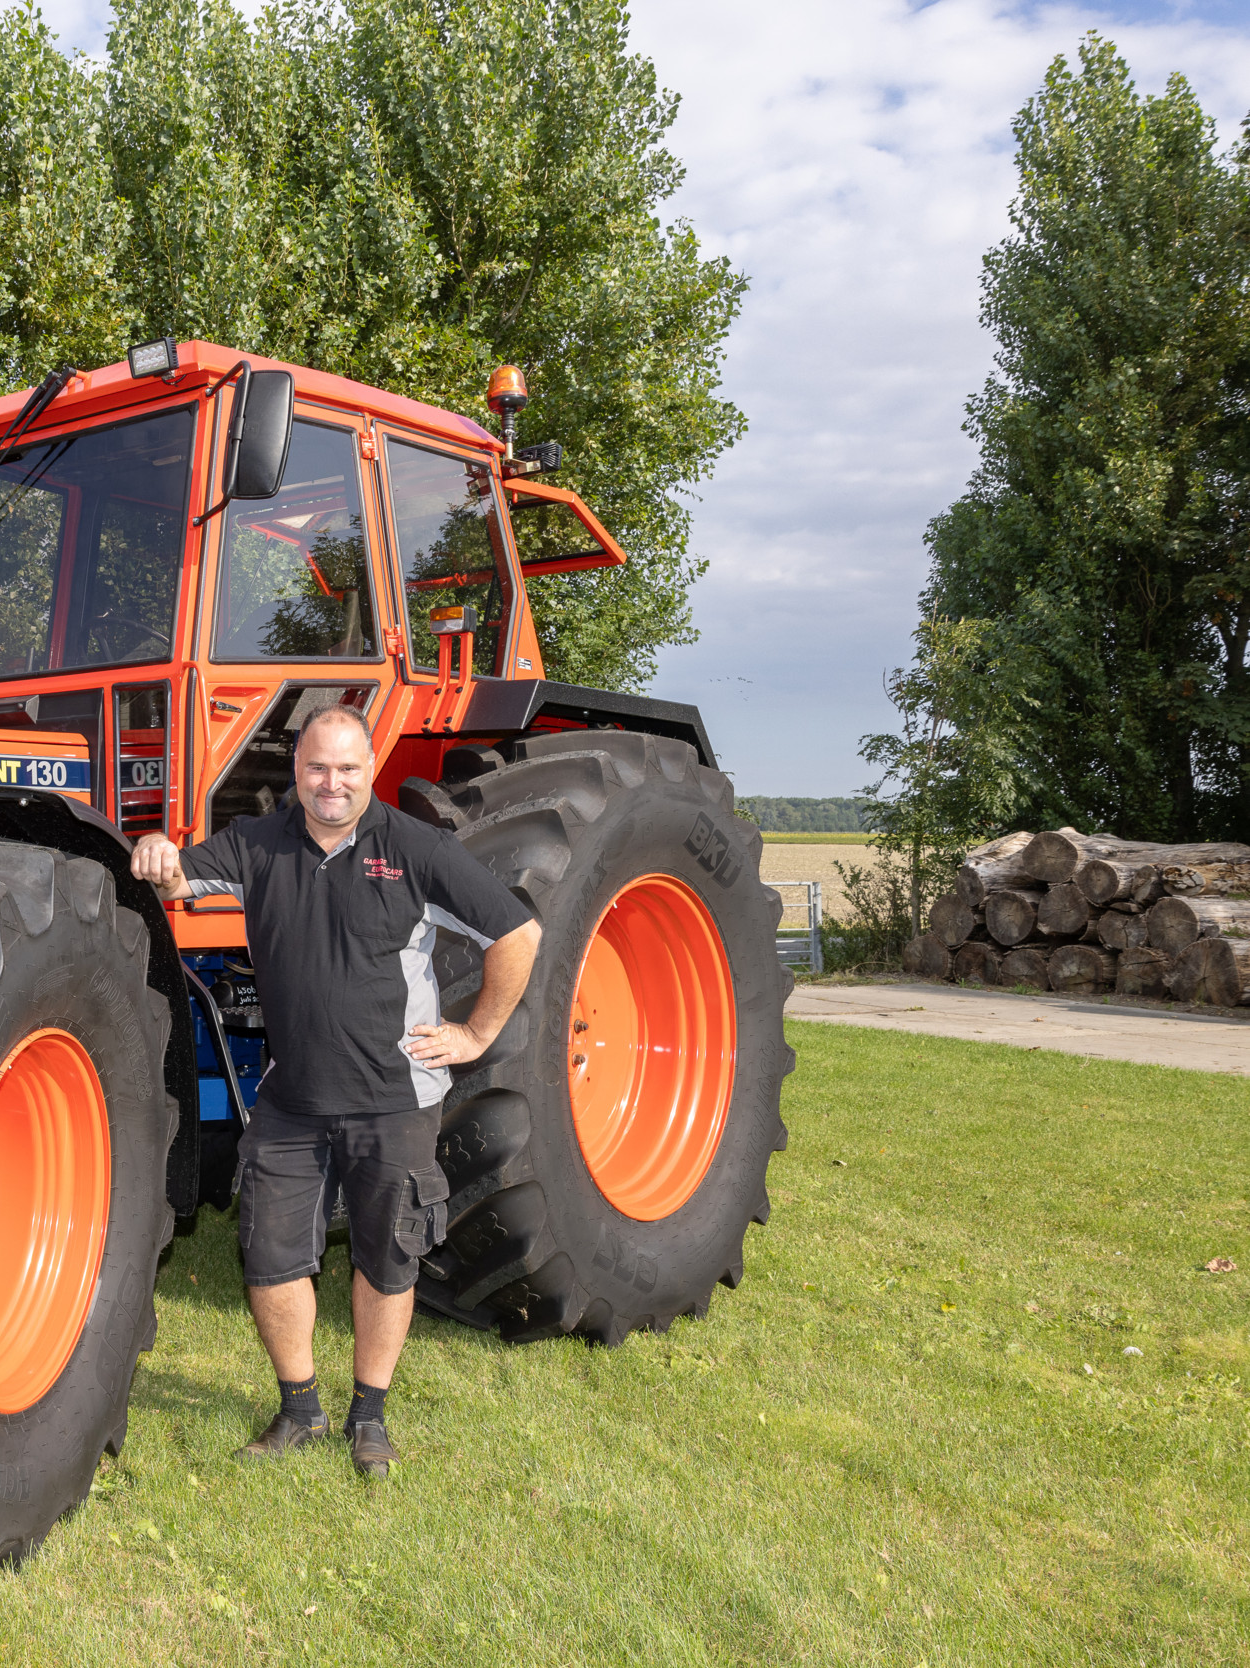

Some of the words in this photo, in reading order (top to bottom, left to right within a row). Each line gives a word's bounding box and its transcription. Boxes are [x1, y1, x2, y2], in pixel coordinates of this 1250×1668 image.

[26, 761, 67, 786] 130
[682, 811, 745, 889] BKT
[363, 857, 387, 866] GARAGE
[371, 865, 403, 877] EUROCARS
